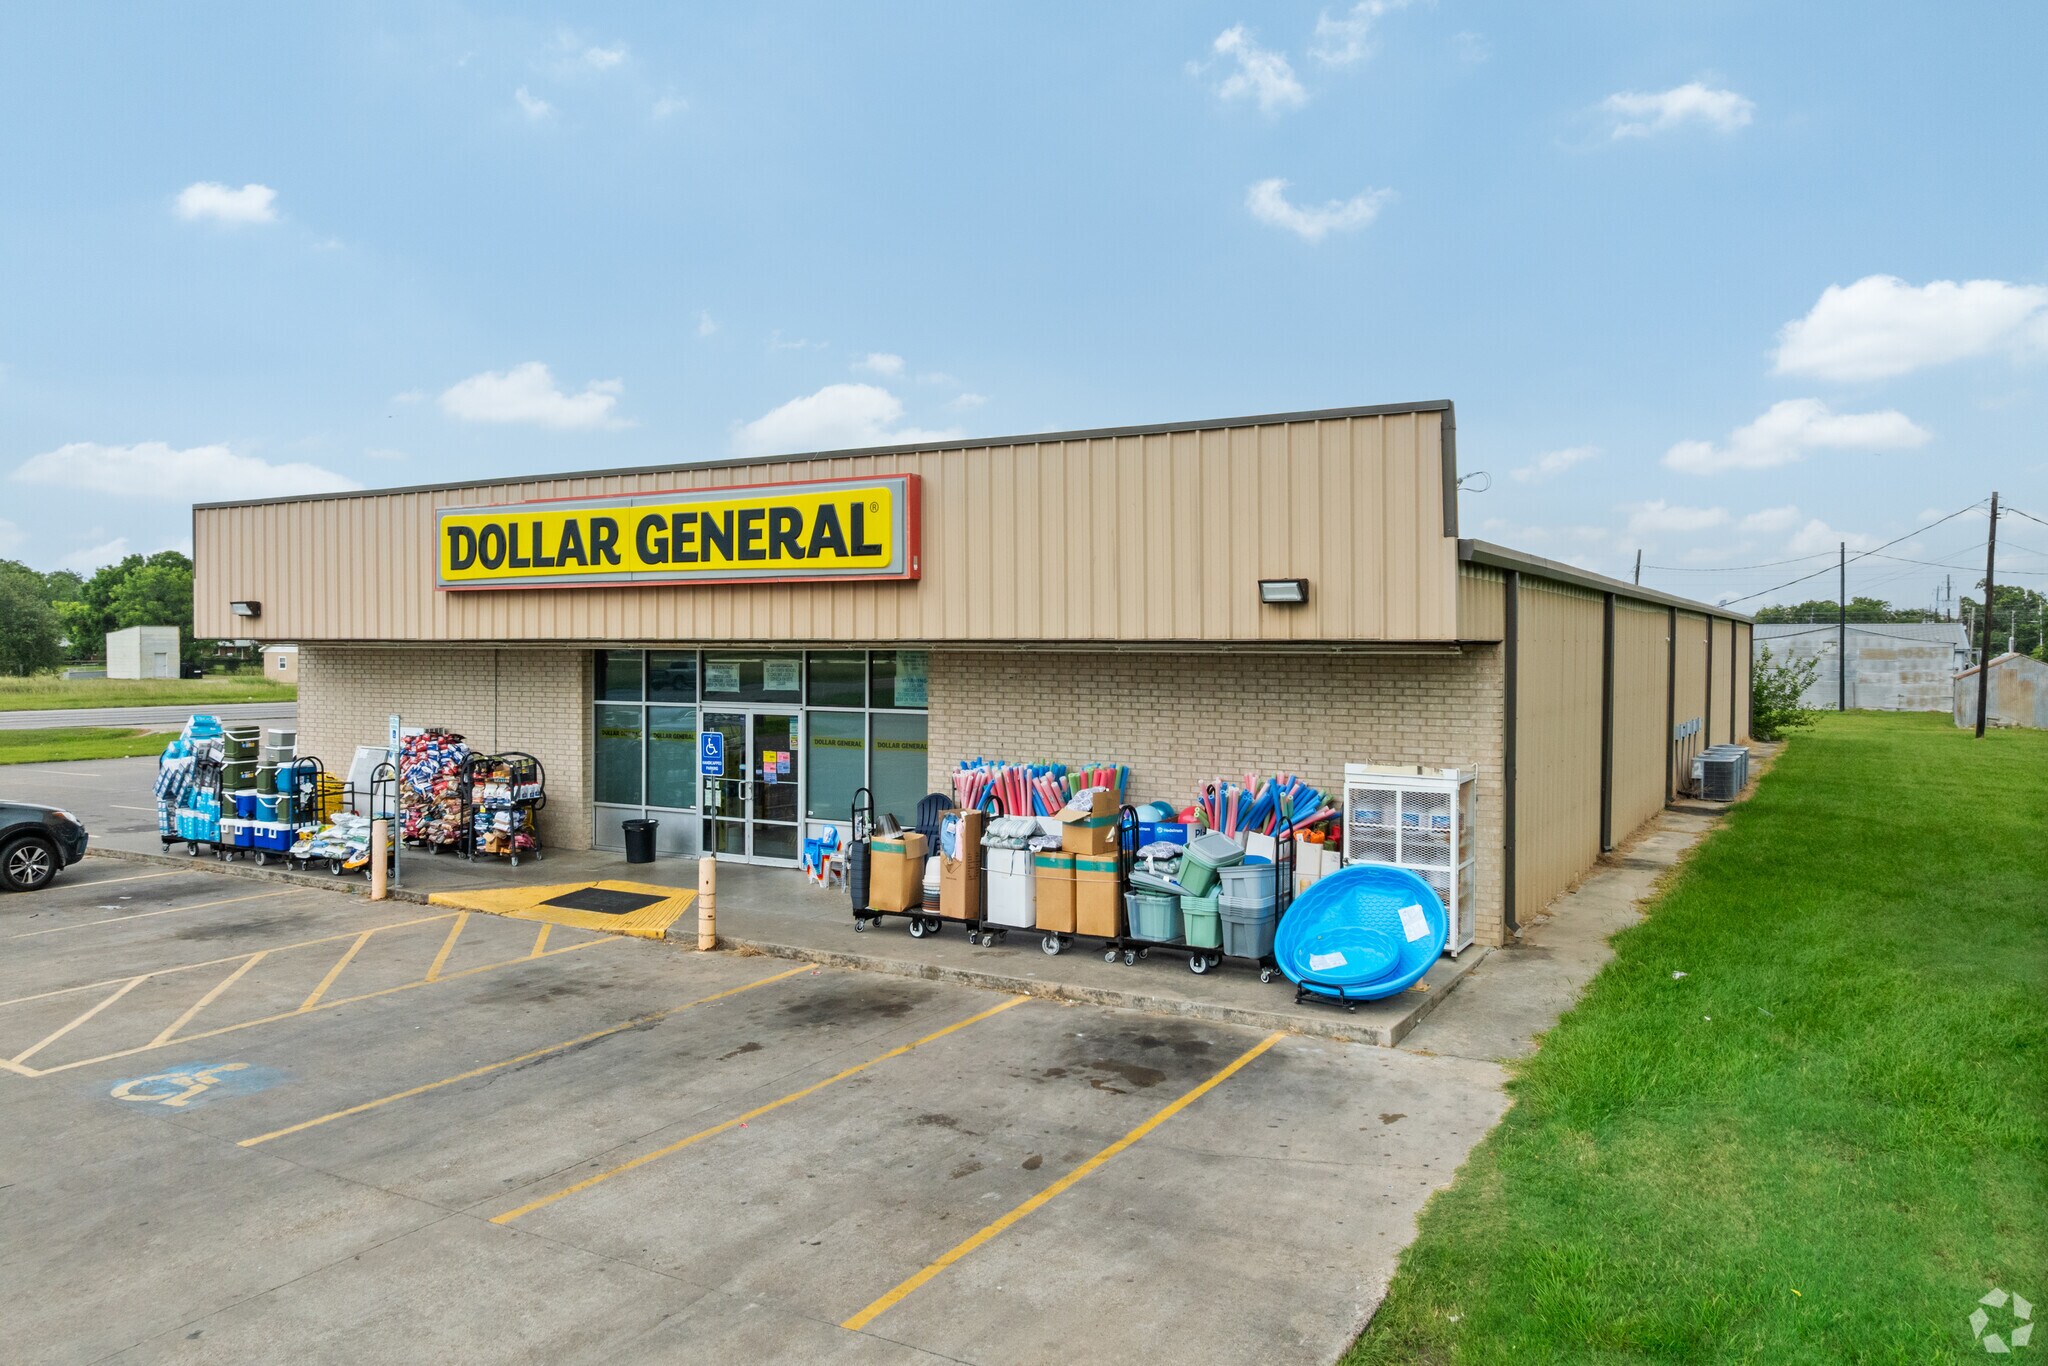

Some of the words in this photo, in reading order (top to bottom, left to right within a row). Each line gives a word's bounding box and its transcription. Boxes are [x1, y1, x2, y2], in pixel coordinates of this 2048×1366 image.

[447, 517, 621, 570] DOLLAR
[635, 501, 882, 566] GENERAL
[814, 738, 837, 746] DOLLAR
[837, 740, 862, 748] GENERAL
[877, 741, 901, 749] DOLLAR
[901, 742, 928, 750] GENERAL
